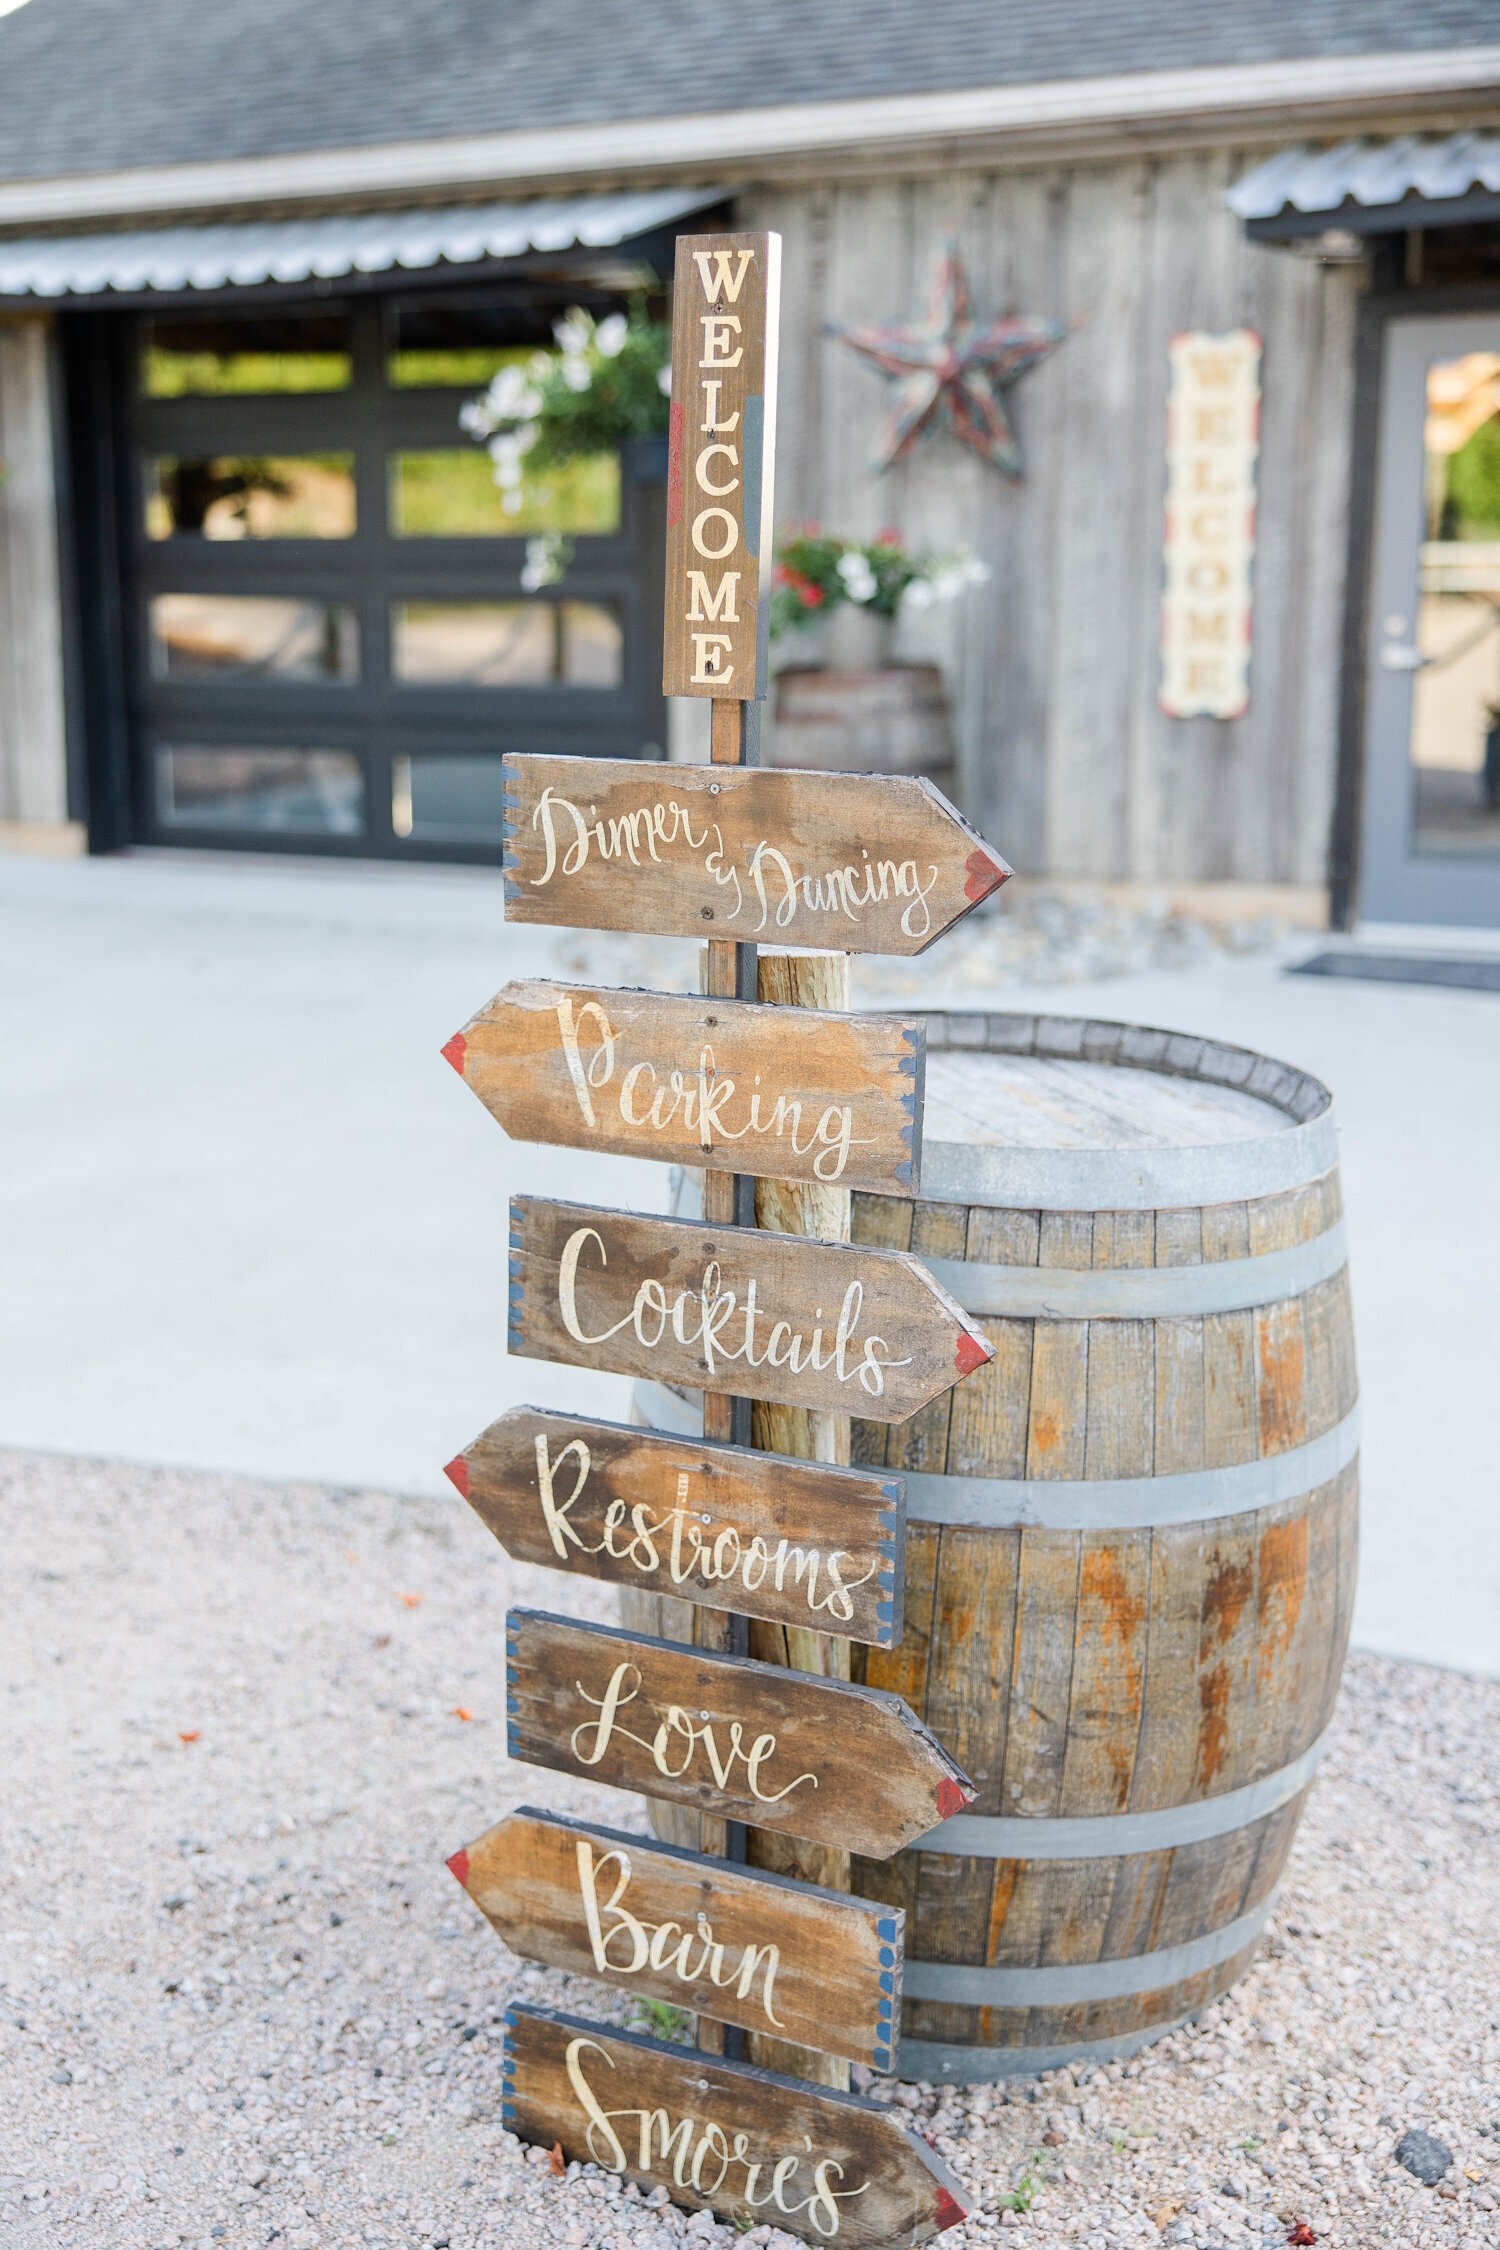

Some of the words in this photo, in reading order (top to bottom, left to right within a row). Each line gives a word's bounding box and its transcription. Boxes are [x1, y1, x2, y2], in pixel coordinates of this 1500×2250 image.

[686, 250, 755, 684] WELCOME
[530, 786, 708, 885] Dinner
[748, 841, 938, 937] Dancing
[556, 998, 879, 1182] Parking
[558, 1227, 912, 1396] Cocktails
[534, 1433, 876, 1621] Restrooms
[570, 1662, 818, 1803] Love
[576, 1841, 785, 2028] Barn
[565, 2038, 871, 2237] Smore's
